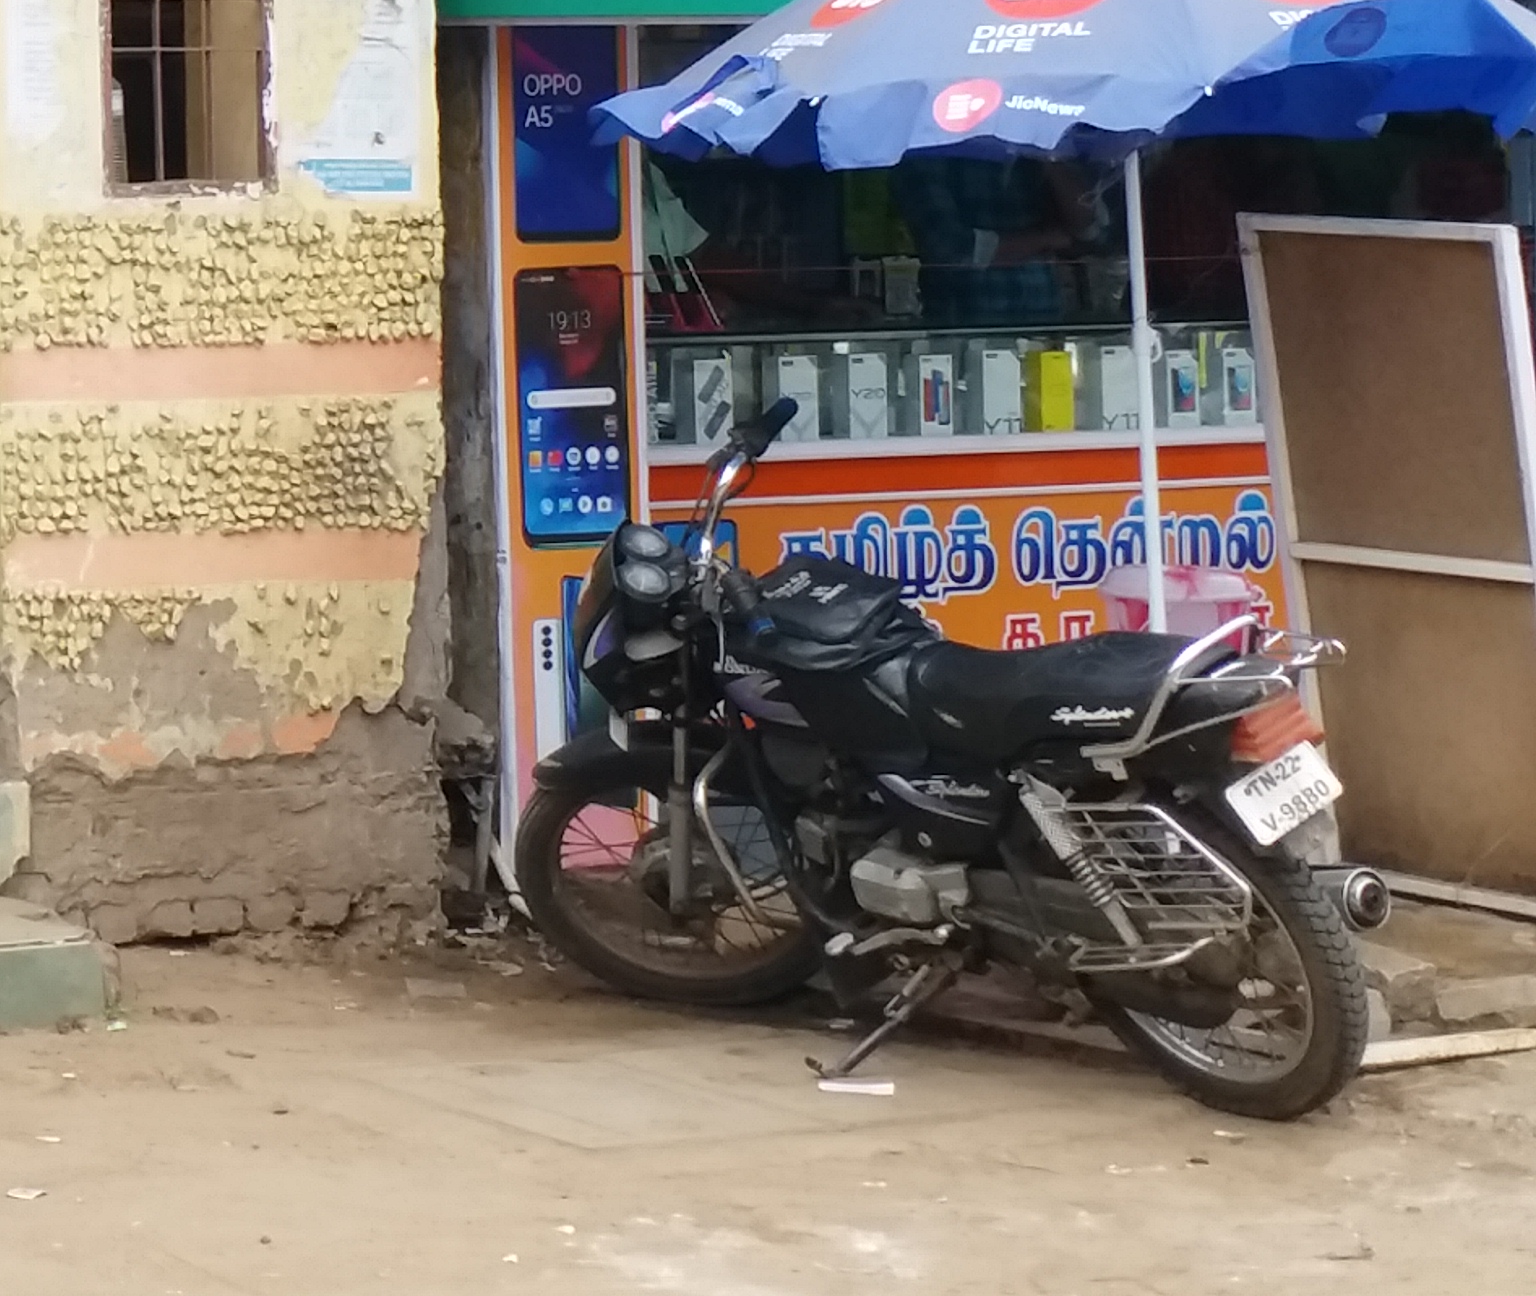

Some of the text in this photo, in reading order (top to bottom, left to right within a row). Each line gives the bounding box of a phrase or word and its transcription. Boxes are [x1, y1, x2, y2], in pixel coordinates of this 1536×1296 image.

[973, 21, 1091, 40] DIGITAL
[967, 37, 1036, 54] LIFE
[523, 73, 583, 97] OPPO
[525, 105, 553, 128] A5
[1013, 489, 1277, 596] தென்றல்
[1245, 754, 1303, 797] TN-22
[1259, 779, 1330, 832] V-9880
